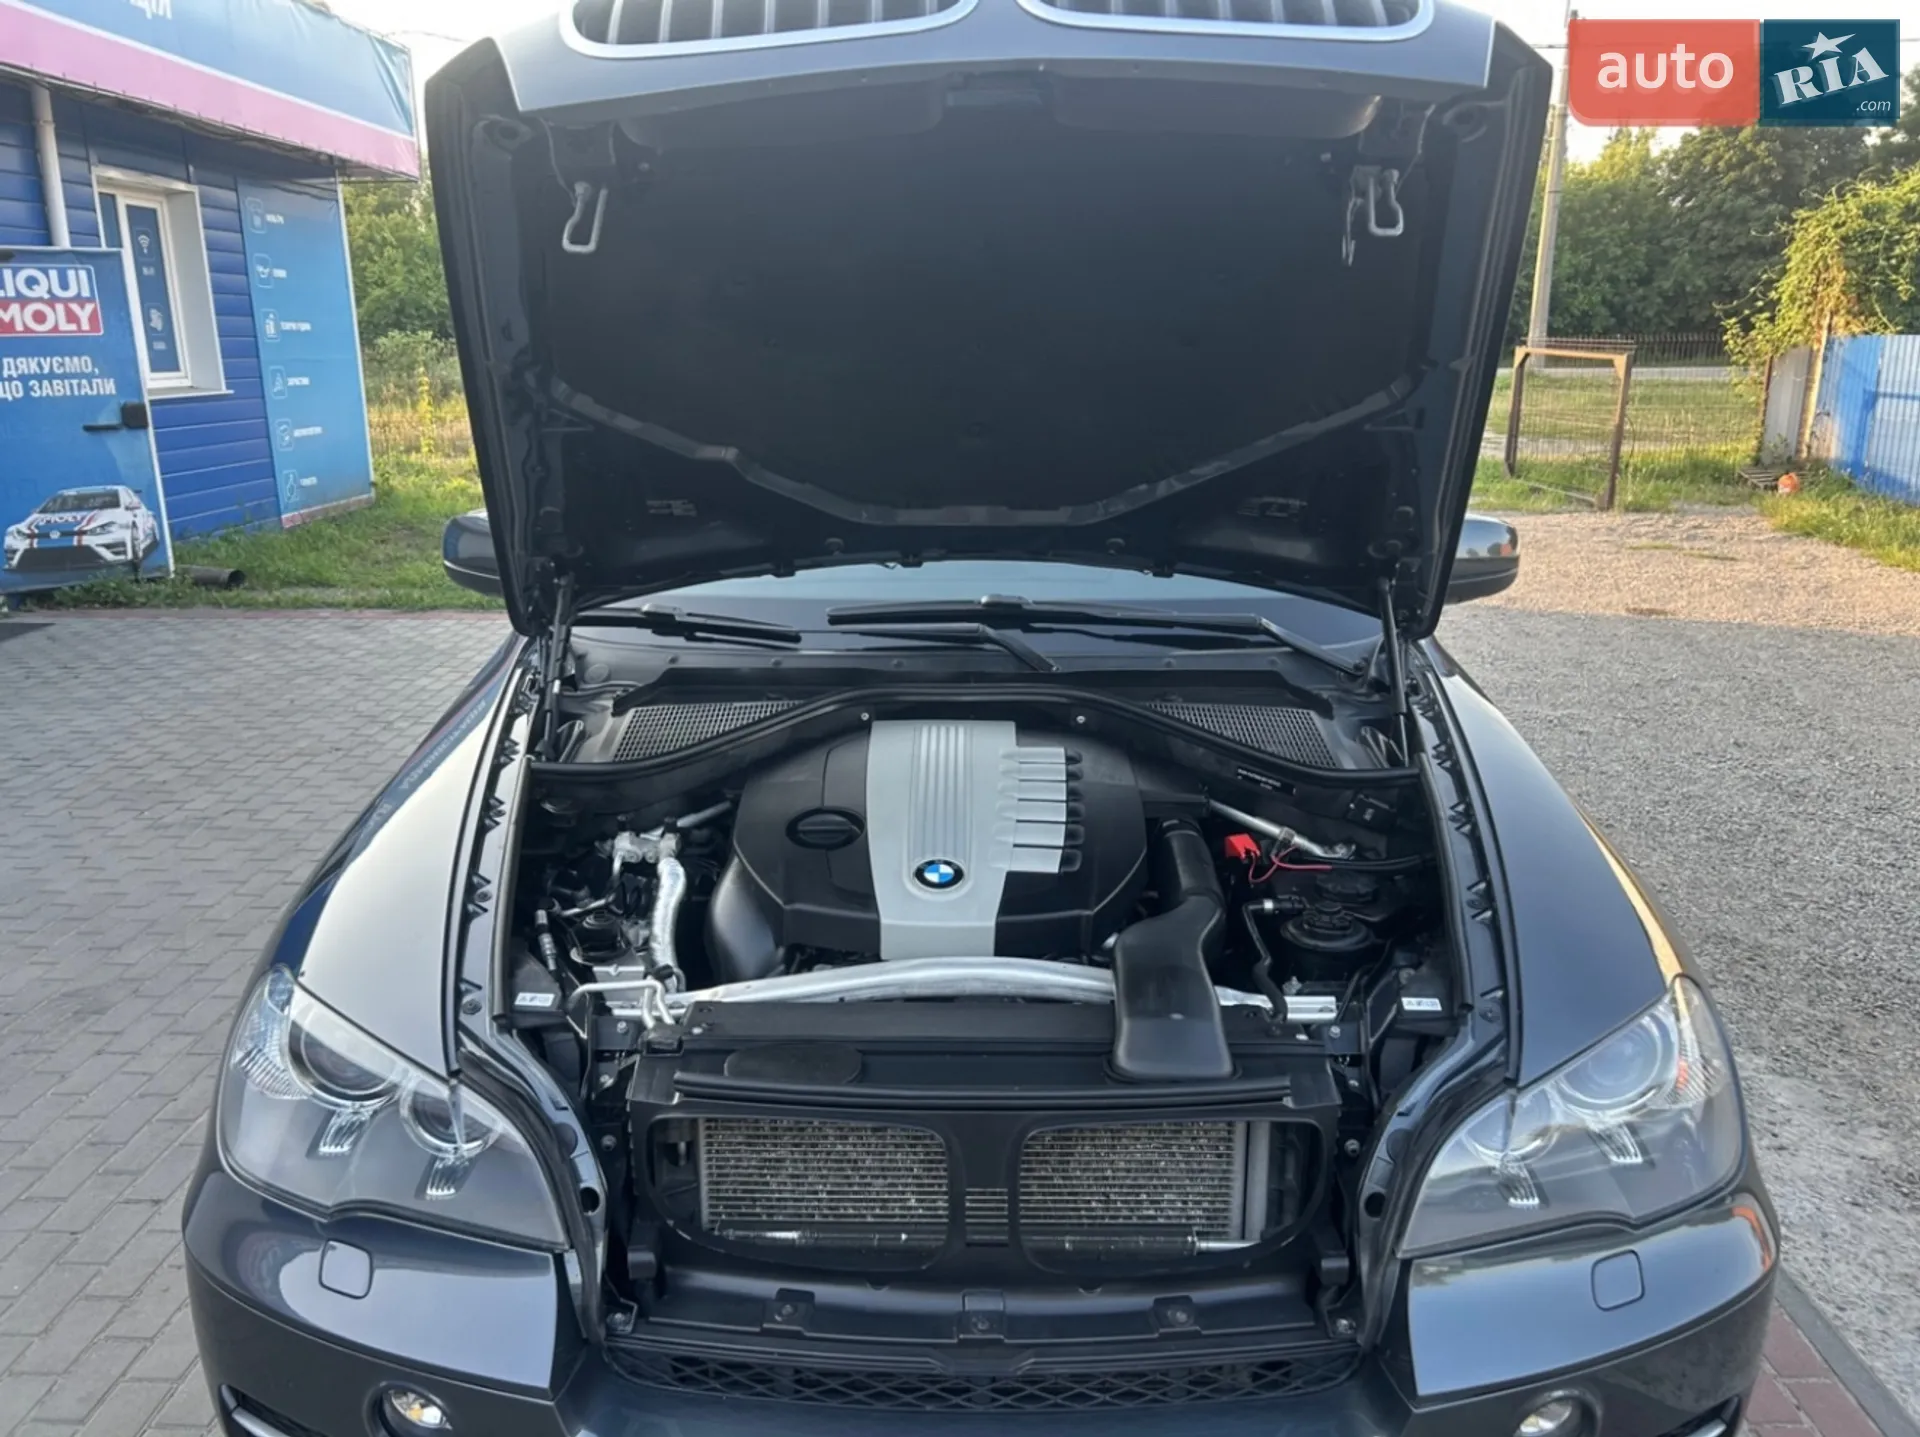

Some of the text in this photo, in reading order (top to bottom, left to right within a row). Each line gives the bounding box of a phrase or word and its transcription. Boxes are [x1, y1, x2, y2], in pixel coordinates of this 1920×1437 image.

[0, 268, 91, 299] IQUI
[0, 302, 96, 332] MOLY
[2, 355, 99, 379] ДЯКУЄМО,
[28, 377, 117, 398] ЗАВІТАЛИ
